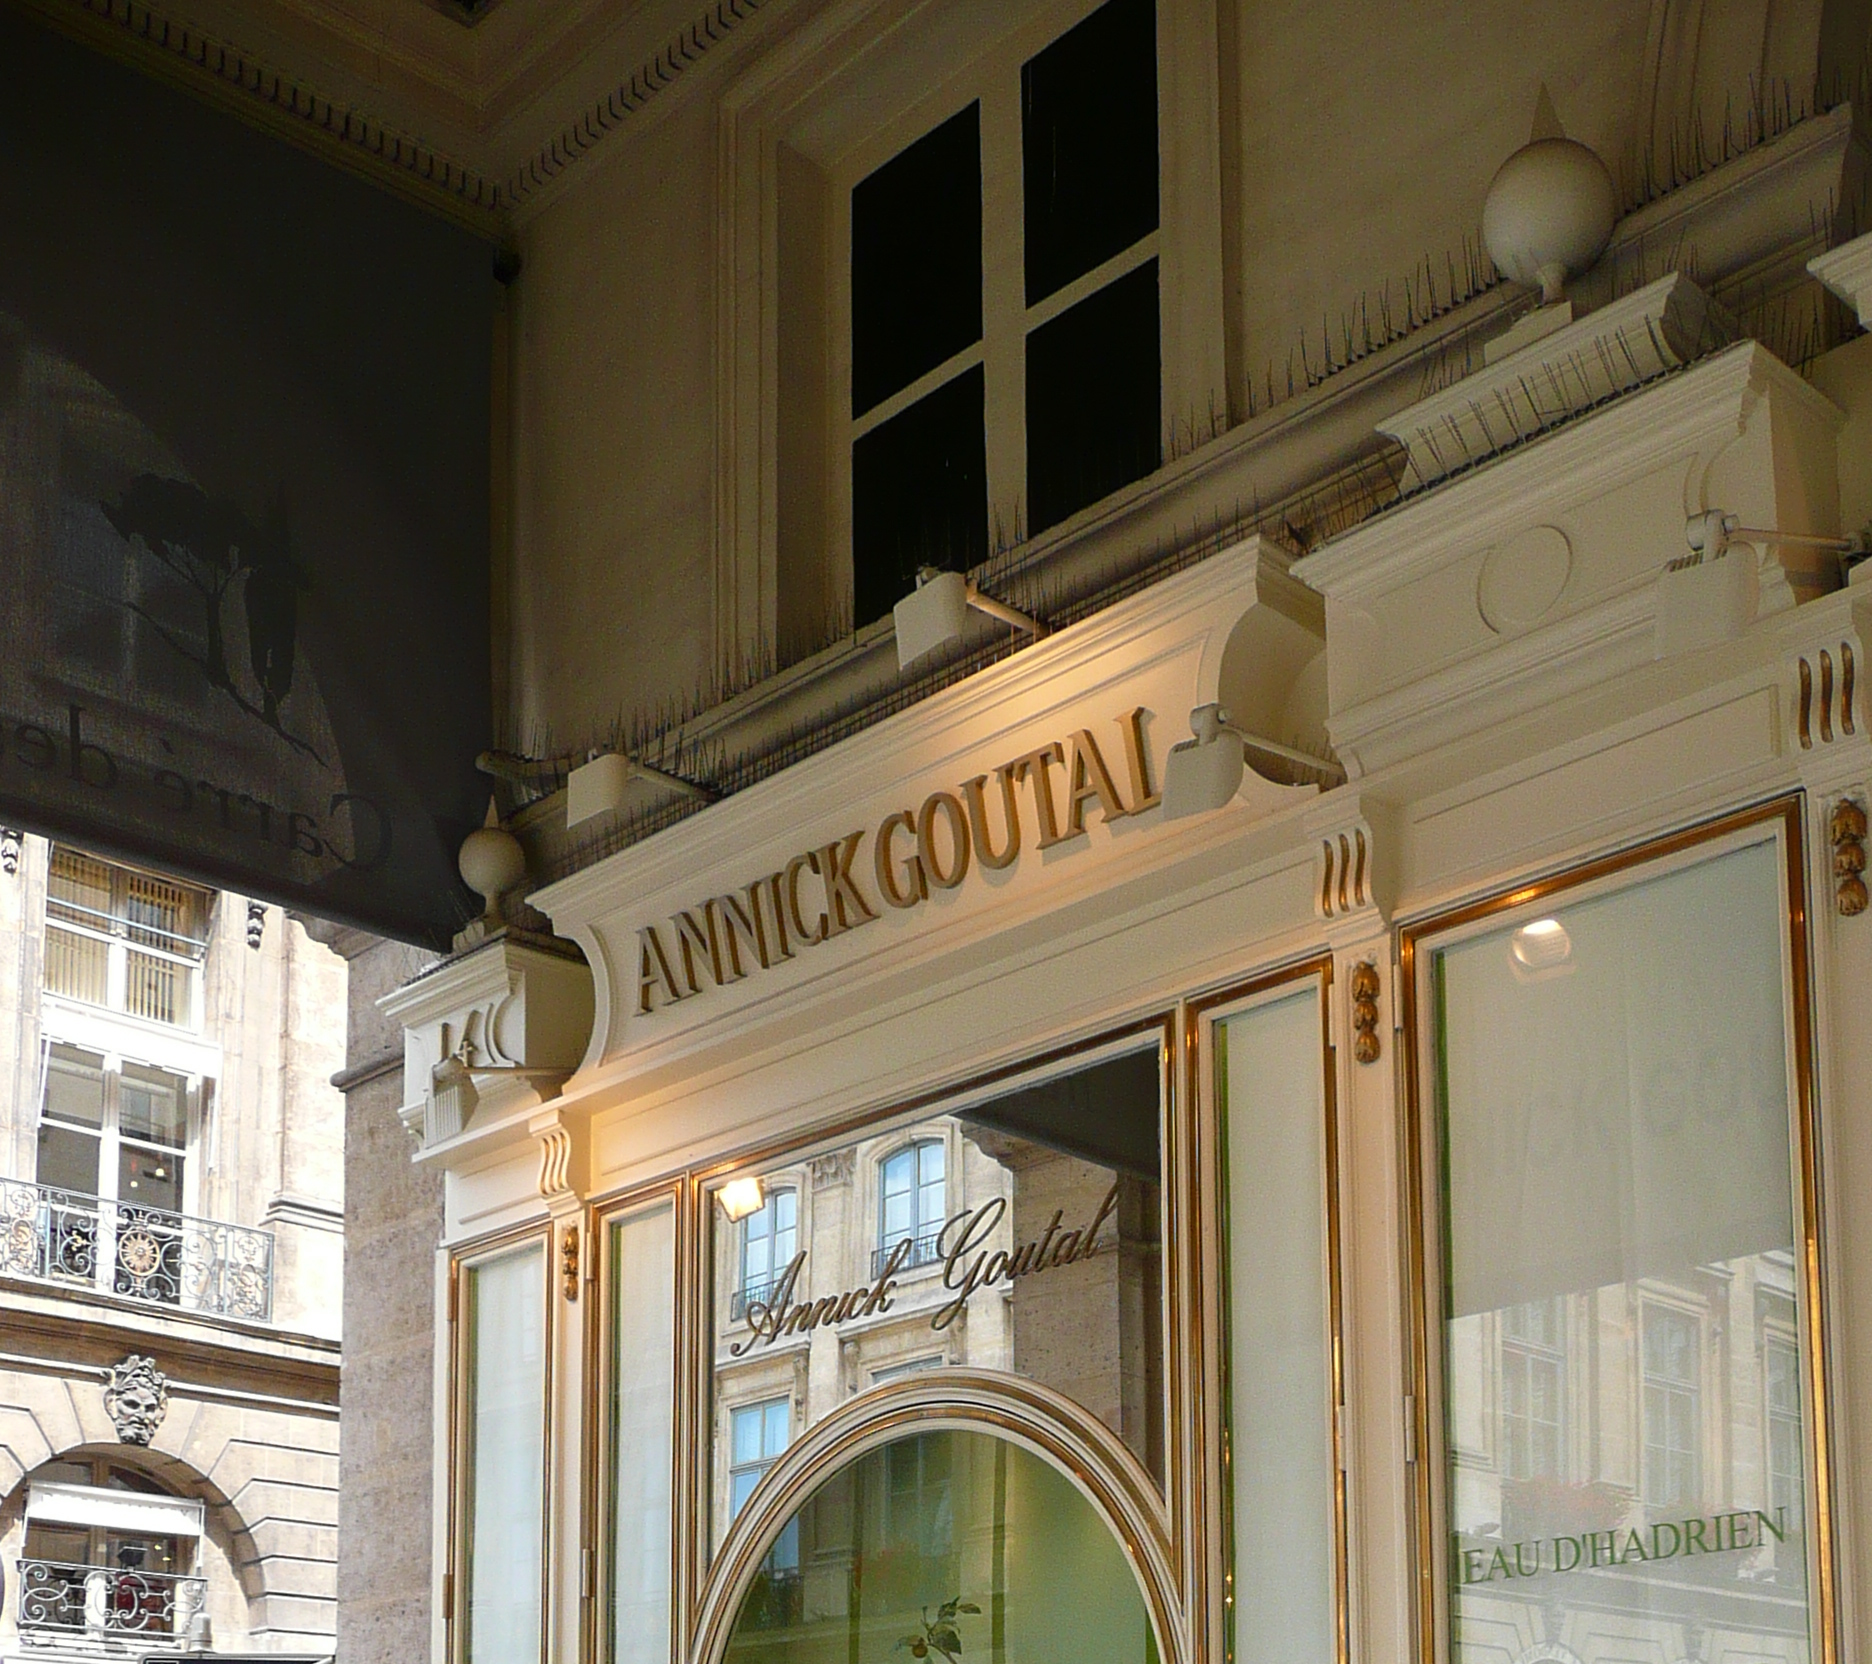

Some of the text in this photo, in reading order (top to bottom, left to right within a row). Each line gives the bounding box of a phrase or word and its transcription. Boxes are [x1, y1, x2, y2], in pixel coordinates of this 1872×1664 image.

[635, 706, 1163, 1017] ANNICK GOUTAL
[730, 1181, 1119, 1357] Annick Goutal
[1462, 1505, 1788, 1586] EAU D'HADRIEN
